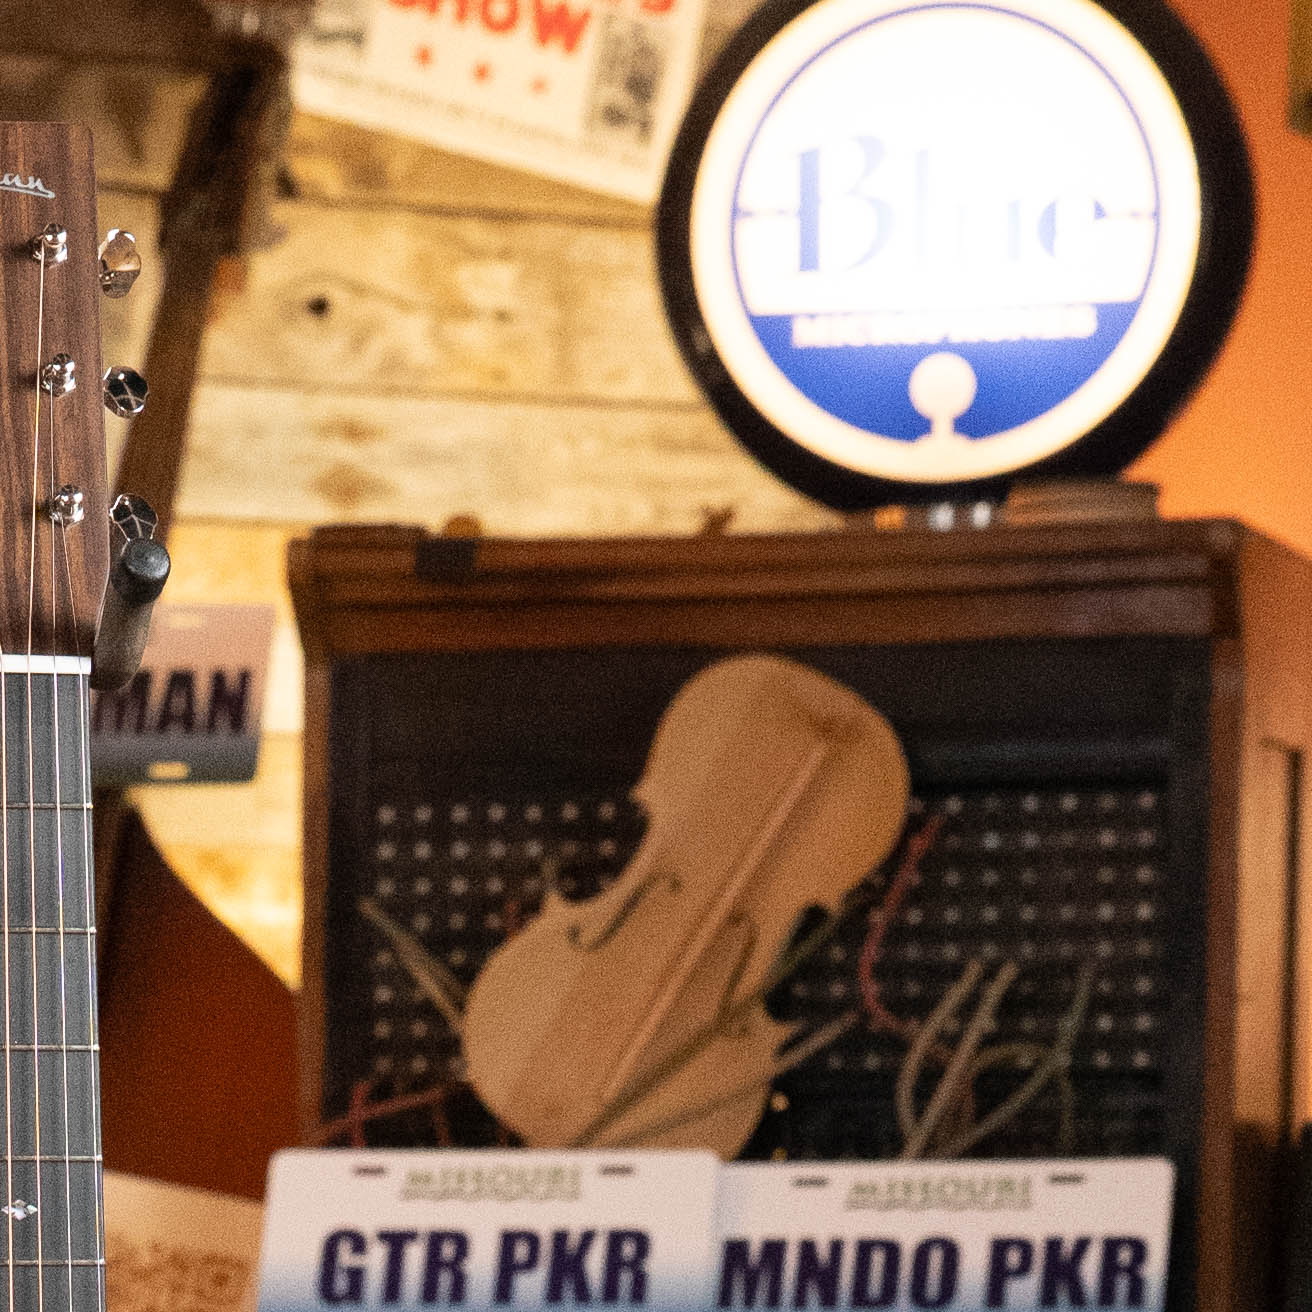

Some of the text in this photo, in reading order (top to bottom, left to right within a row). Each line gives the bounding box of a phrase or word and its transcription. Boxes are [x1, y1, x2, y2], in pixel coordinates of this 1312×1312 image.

[315, 1226, 470, 1306] GTR
[491, 1228, 653, 1306] PKR
[718, 1234, 1151, 1312] MNDO PKR
